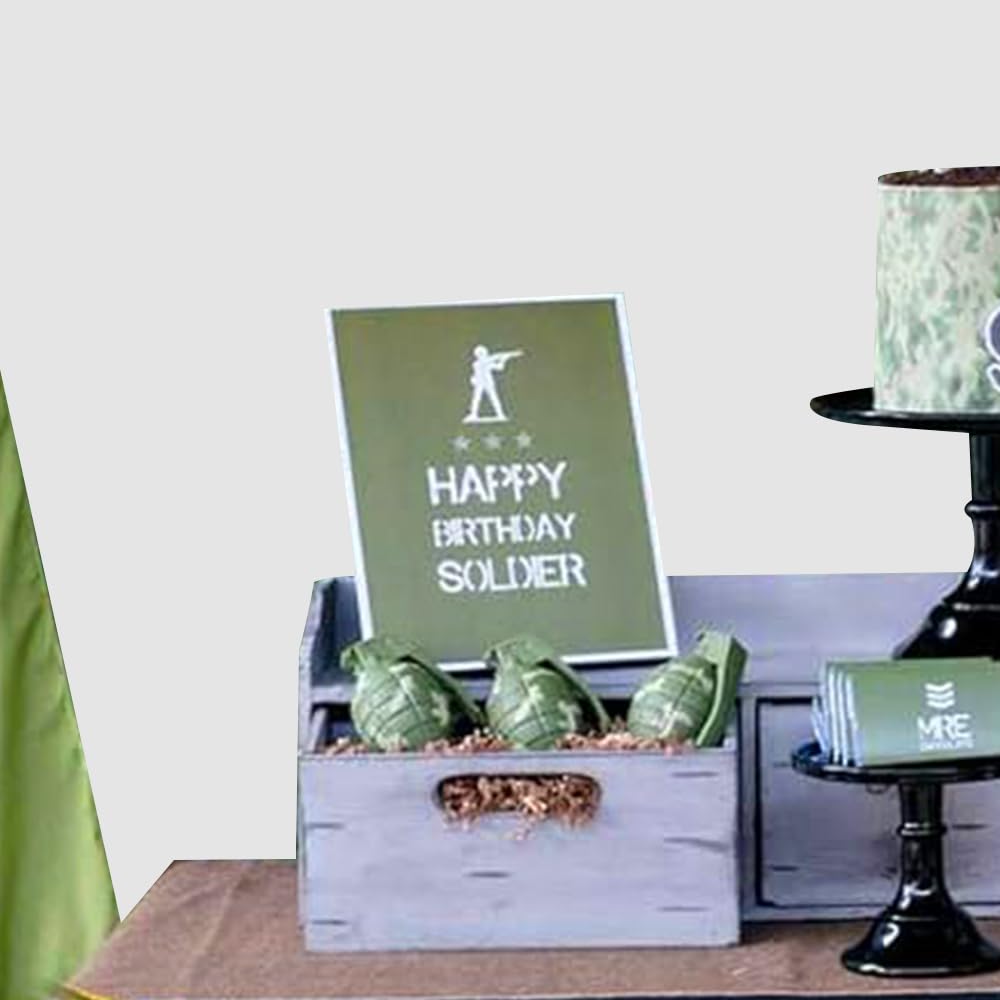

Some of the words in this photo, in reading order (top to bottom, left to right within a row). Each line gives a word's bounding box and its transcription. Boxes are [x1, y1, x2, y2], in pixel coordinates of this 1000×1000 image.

[427, 461, 567, 505] HAPPY
[432, 512, 576, 547] BIRTHDAY
[437, 553, 587, 592] SOLDIER
[917, 713, 971, 739] MRE
